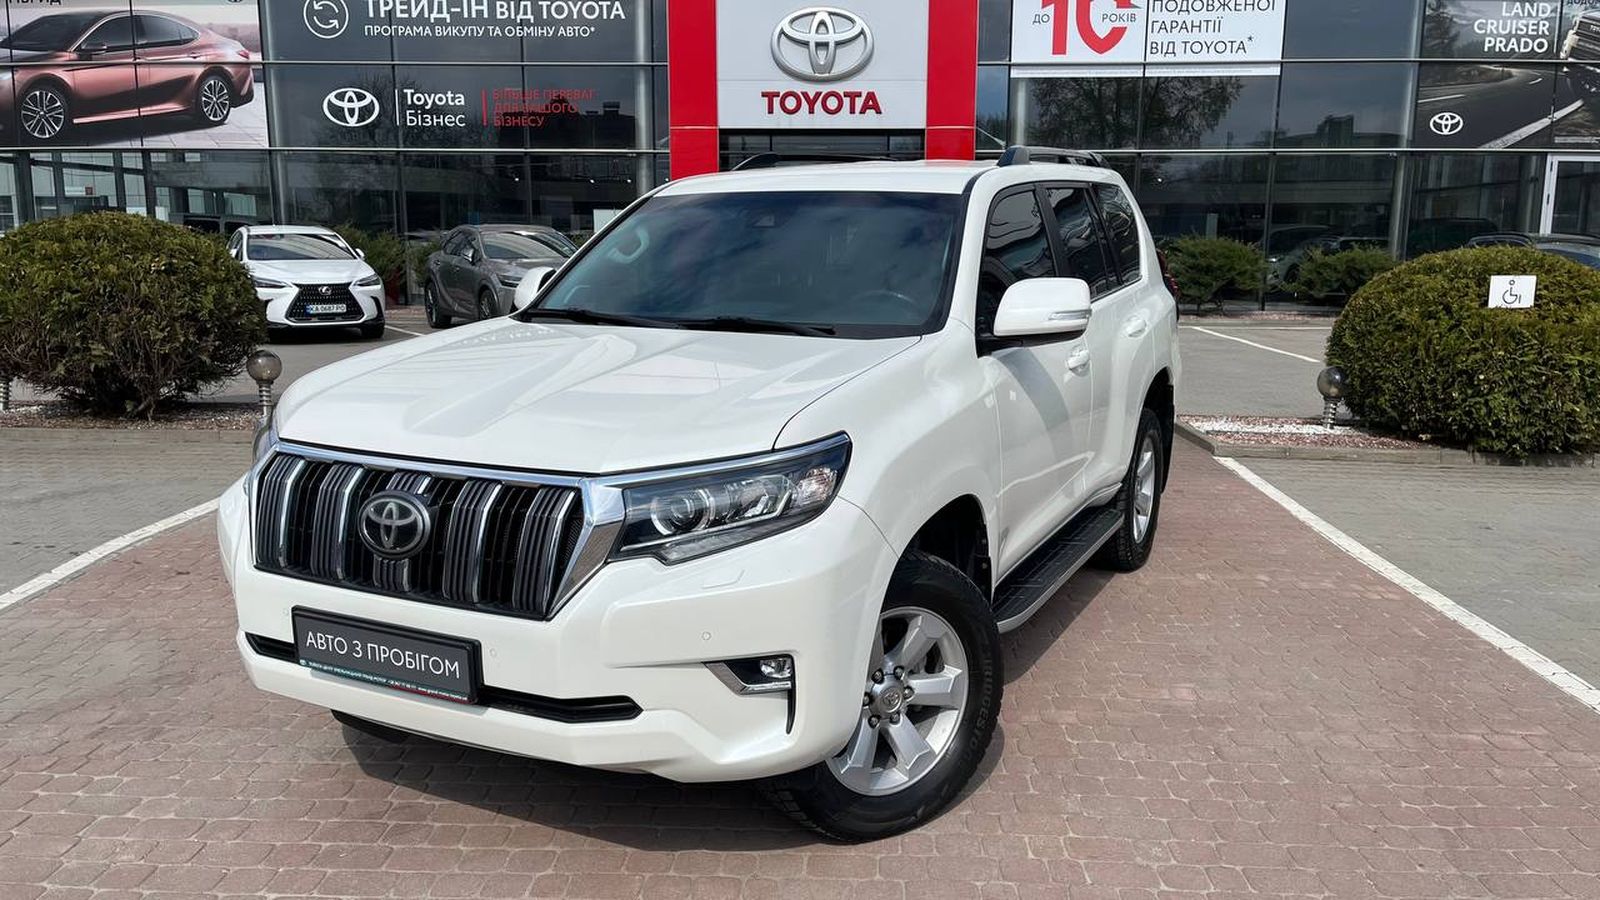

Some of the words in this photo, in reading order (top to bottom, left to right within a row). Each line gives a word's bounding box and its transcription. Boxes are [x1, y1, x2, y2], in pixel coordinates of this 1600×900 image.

[495, 1, 534, 22] ВІД
[538, 1, 626, 20] TOYOTA
[1501, 2, 1551, 17] LAND
[1032, 13, 1050, 25] ДО
[1101, 13, 1137, 24] РОКІВ
[1150, 16, 1223, 34] ГАРАНТІЇ
[1473, 19, 1550, 36] CRUISER
[364, 25, 432, 37] ПРОГРАМА
[435, 25, 485, 37] ВИКУПУ
[487, 26, 501, 37] ТА
[504, 26, 555, 37] ОБМІНУ
[1149, 41, 1177, 57] ВІД
[1483, 37, 1549, 54] PRADO
[403, 89, 466, 109] Toyota
[760, 91, 882, 115] TOYOTA
[406, 109, 467, 127] Бізнес
[493, 115, 545, 127] БІЗНЕСУ
[306, 631, 348, 655] АВТО
[367, 643, 460, 679] ПРОБІГОМ
